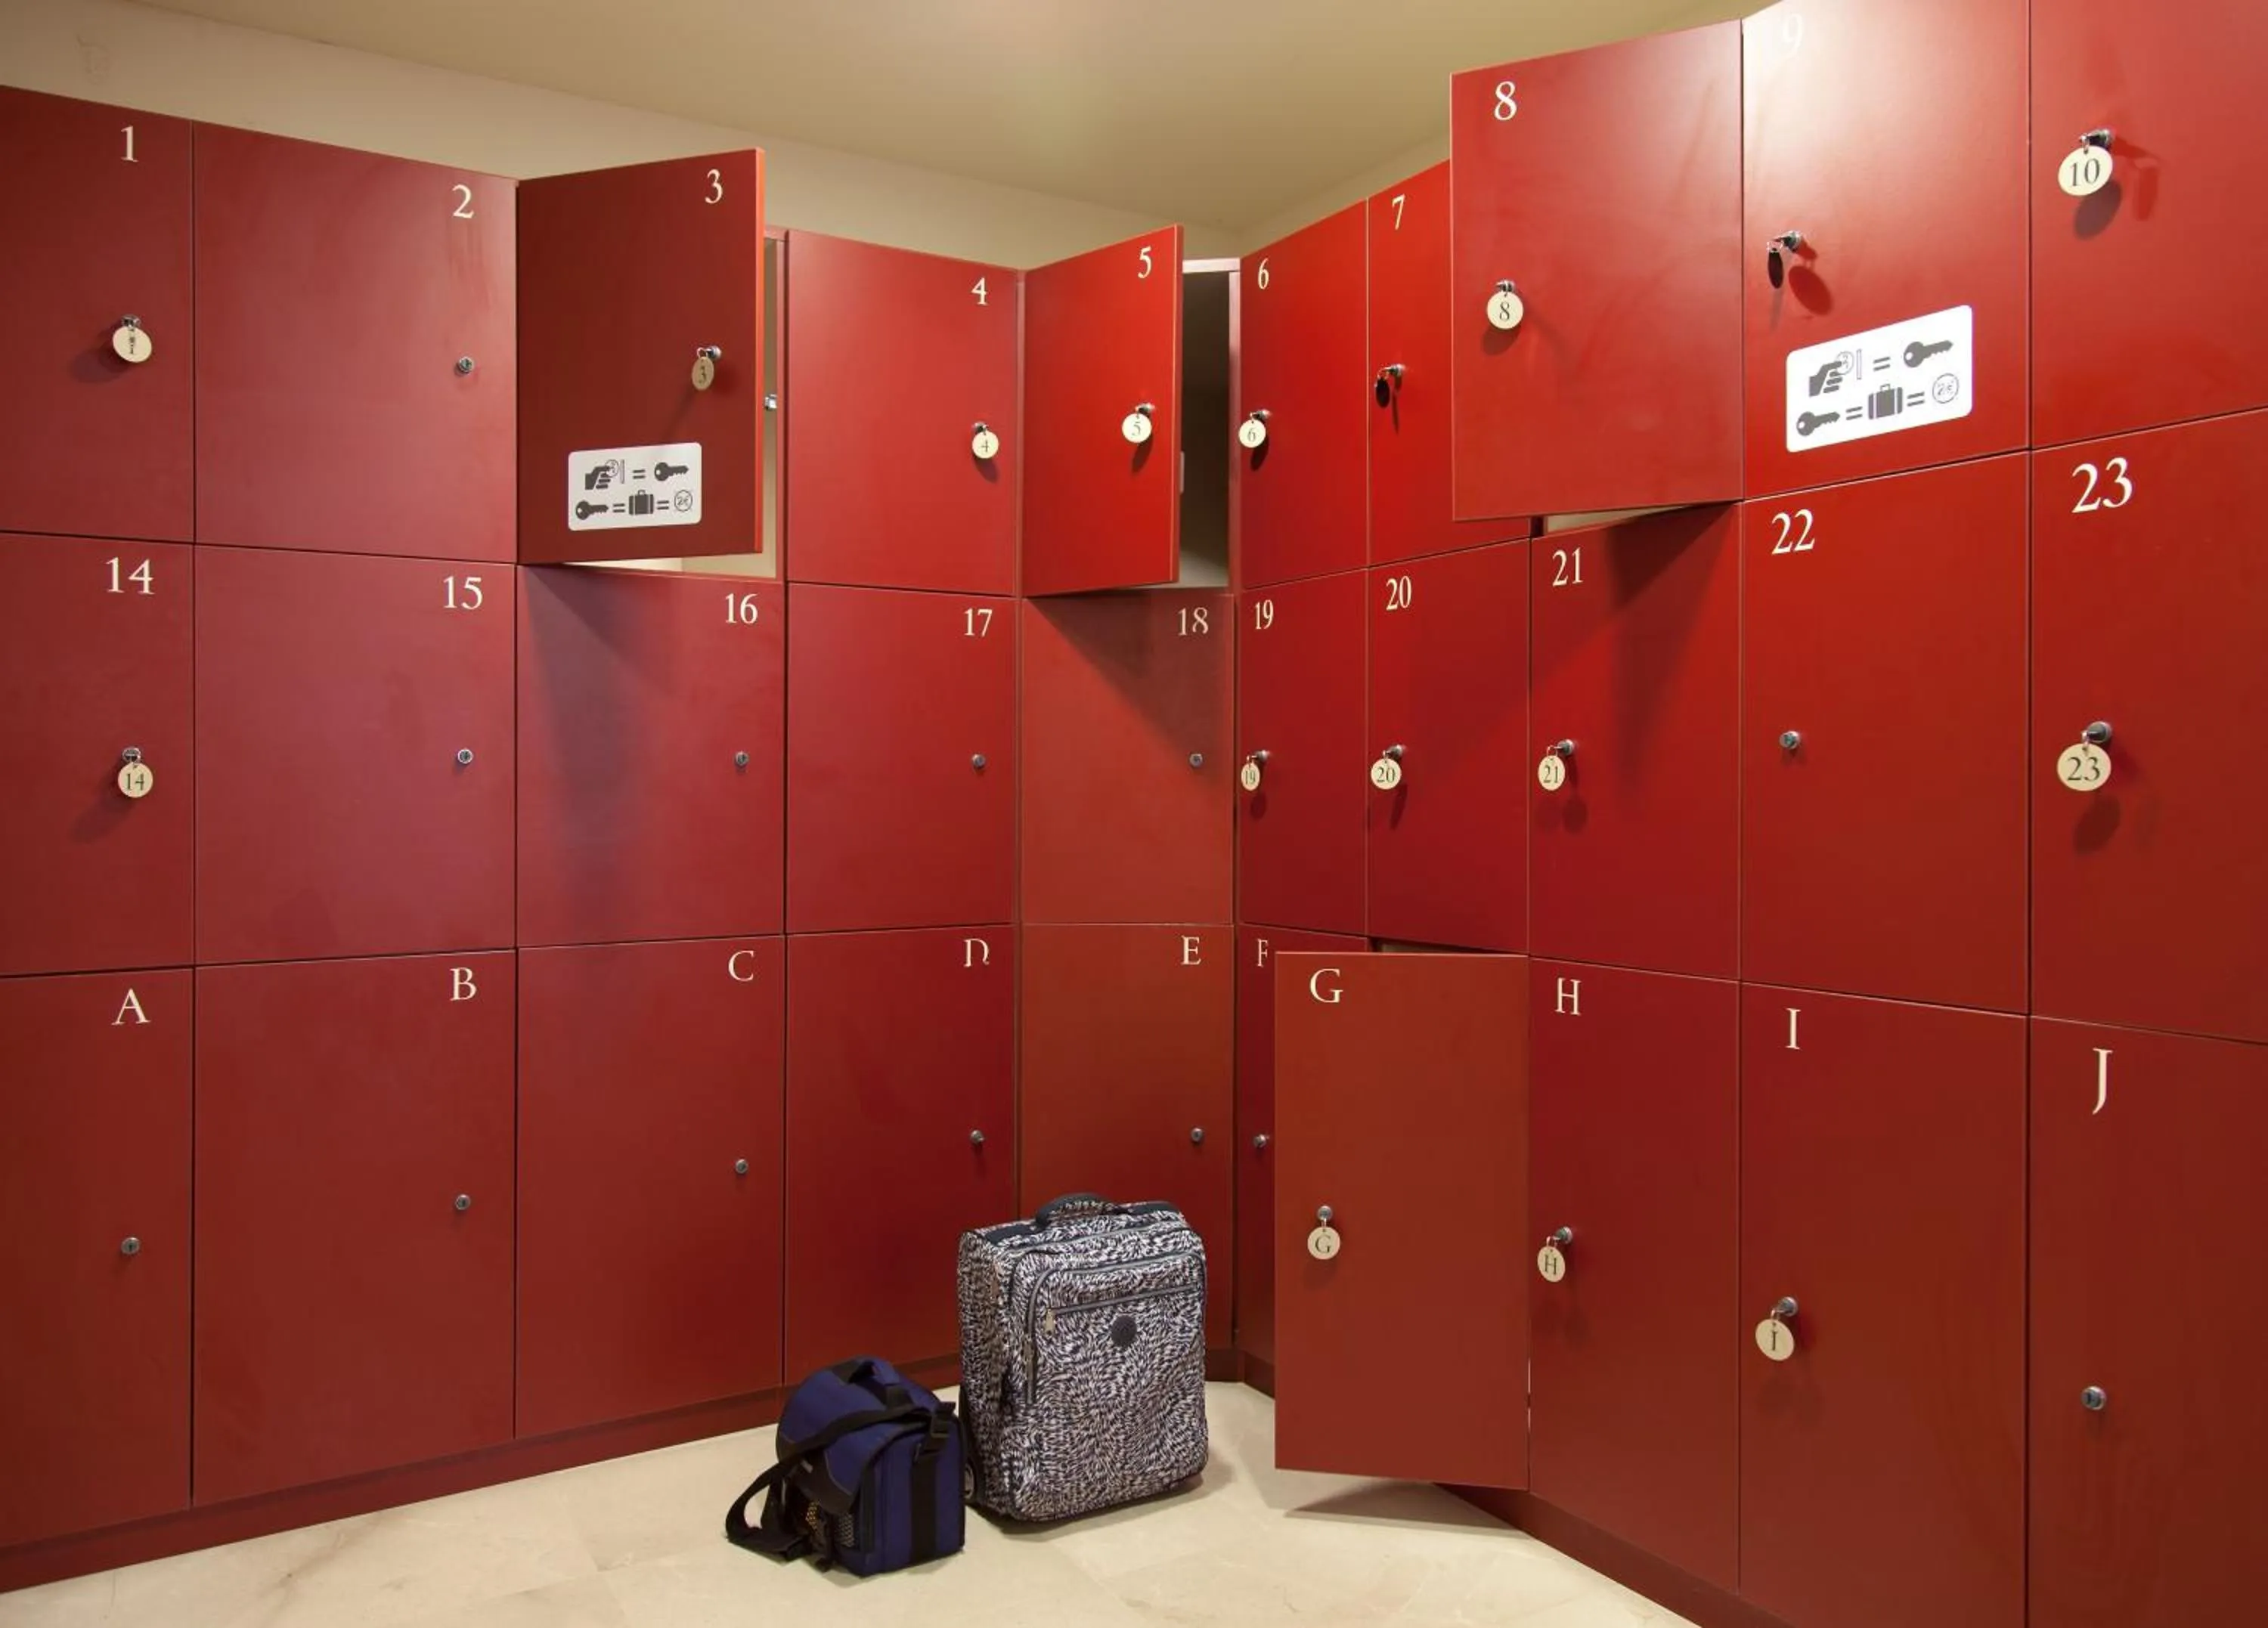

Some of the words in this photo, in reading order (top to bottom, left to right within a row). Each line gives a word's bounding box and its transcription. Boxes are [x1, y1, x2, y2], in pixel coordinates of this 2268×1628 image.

[1495, 82, 1517, 120] 8
[121, 125, 138, 162] 1
[705, 169, 723, 204] 3
[2070, 157, 2100, 187] 10
[452, 184, 475, 218] 2
[1391, 194, 1405, 230] 7
[1138, 246, 1151, 278] 5
[1258, 258, 1269, 289] 6
[971, 277, 987, 305] 4
[1498, 301, 1510, 321] 8
[1132, 421, 1142, 435] 5
[1247, 428, 1256, 442] 6
[981, 439, 990, 452] 4
[2072, 457, 2132, 512] 23
[1772, 509, 1814, 554] 22
[107, 556, 154, 595] 14
[1553, 548, 1582, 586] 21
[442, 576, 484, 611] 15
[726, 593, 758, 623] 16
[1387, 576, 1411, 610] 20
[964, 608, 993, 636] 17
[1180, 608, 1208, 635] 18
[1256, 600, 1273, 629] 19
[125, 772, 145, 791] 14
[1244, 769, 1256, 784] 19
[1376, 766, 1396, 783] 20
[1543, 766, 1559, 783] 21
[2067, 756, 2101, 782] 23
[728, 950, 754, 981] C
[1181, 936, 1201, 965] E
[1257, 938, 1269, 967] F
[450, 967, 477, 1001] B
[1309, 968, 1343, 1002] G
[1554, 976, 1581, 1016] H
[111, 988, 150, 1025] A
[2093, 1048, 2112, 1113] J
[1314, 1235, 1331, 1254] G
[1544, 1256, 1557, 1276] H
